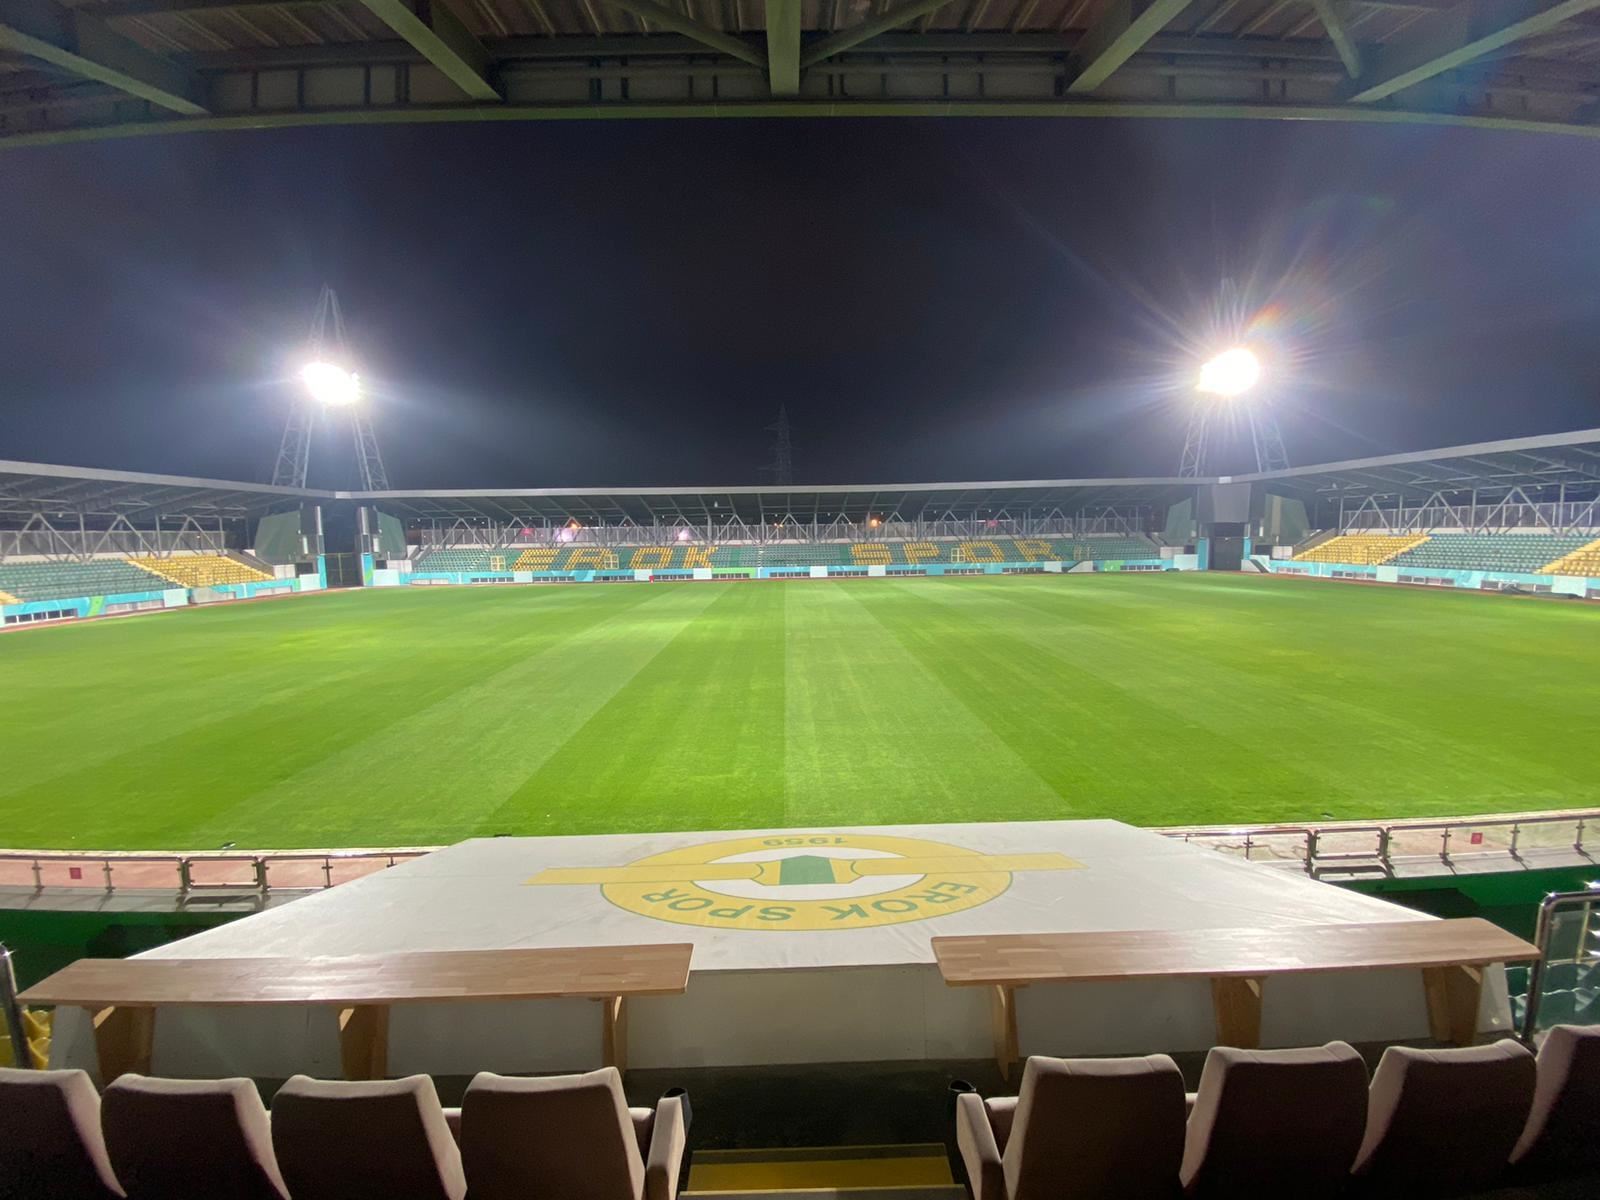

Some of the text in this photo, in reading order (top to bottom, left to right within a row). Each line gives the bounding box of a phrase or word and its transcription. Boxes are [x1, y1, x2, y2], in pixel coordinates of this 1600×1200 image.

[512, 541, 1063, 571] EROK SPOR
[763, 836, 848, 847] 1959
[642, 880, 978, 922] EROK SPOR
